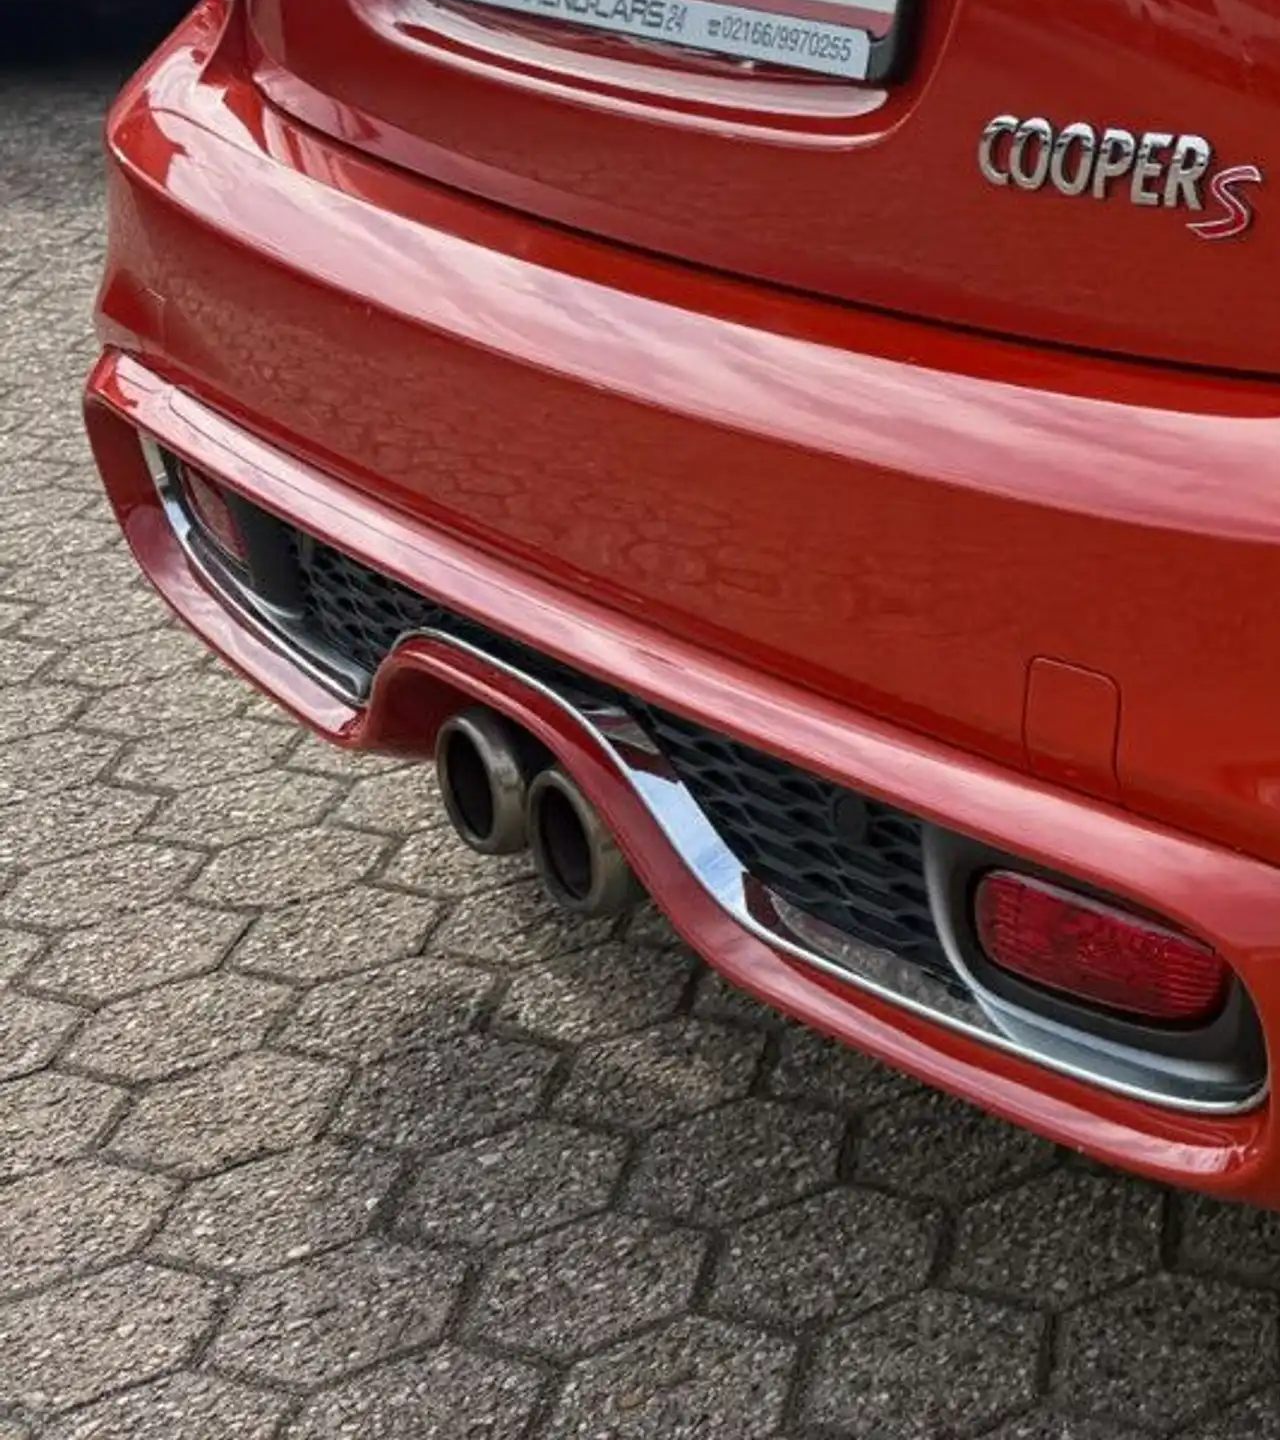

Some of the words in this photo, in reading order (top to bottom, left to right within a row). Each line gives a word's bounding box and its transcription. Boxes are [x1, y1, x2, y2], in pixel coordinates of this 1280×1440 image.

[720, 15, 853, 62] 02166/9970255
[978, 114, 1211, 211] COOPER
[1185, 164, 1263, 240] S
